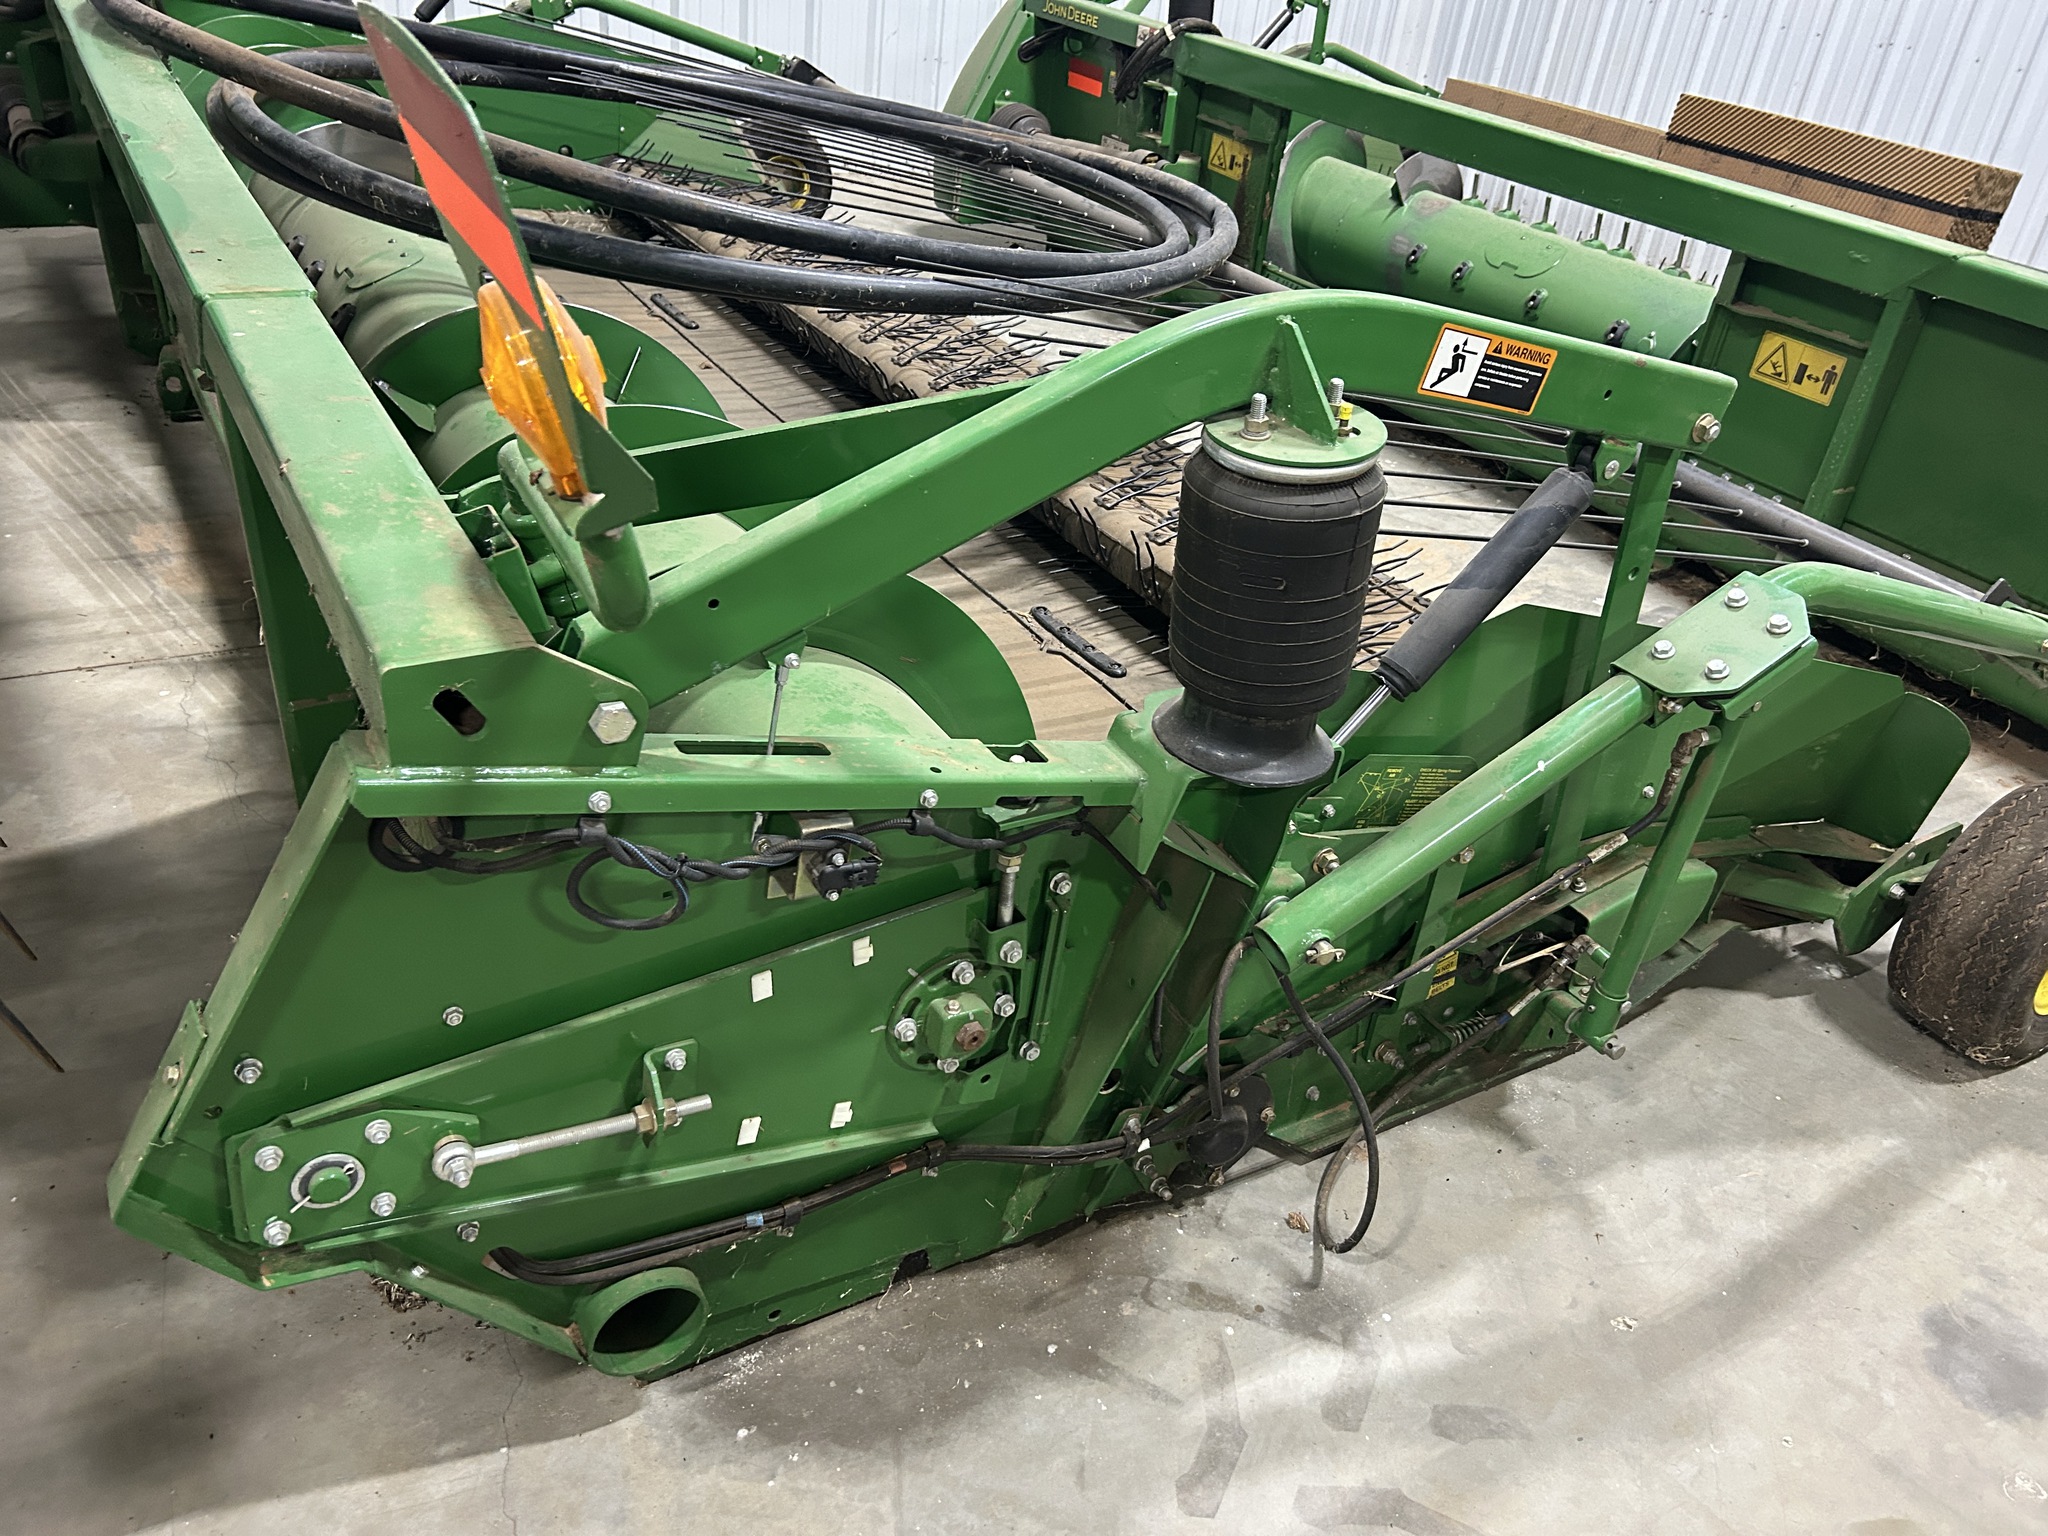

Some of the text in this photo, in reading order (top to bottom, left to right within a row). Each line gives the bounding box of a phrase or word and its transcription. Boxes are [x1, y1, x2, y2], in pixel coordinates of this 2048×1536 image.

[1042, 0, 1099, 29] JOHN DEERE
[1505, 343, 1552, 365] WARNING
